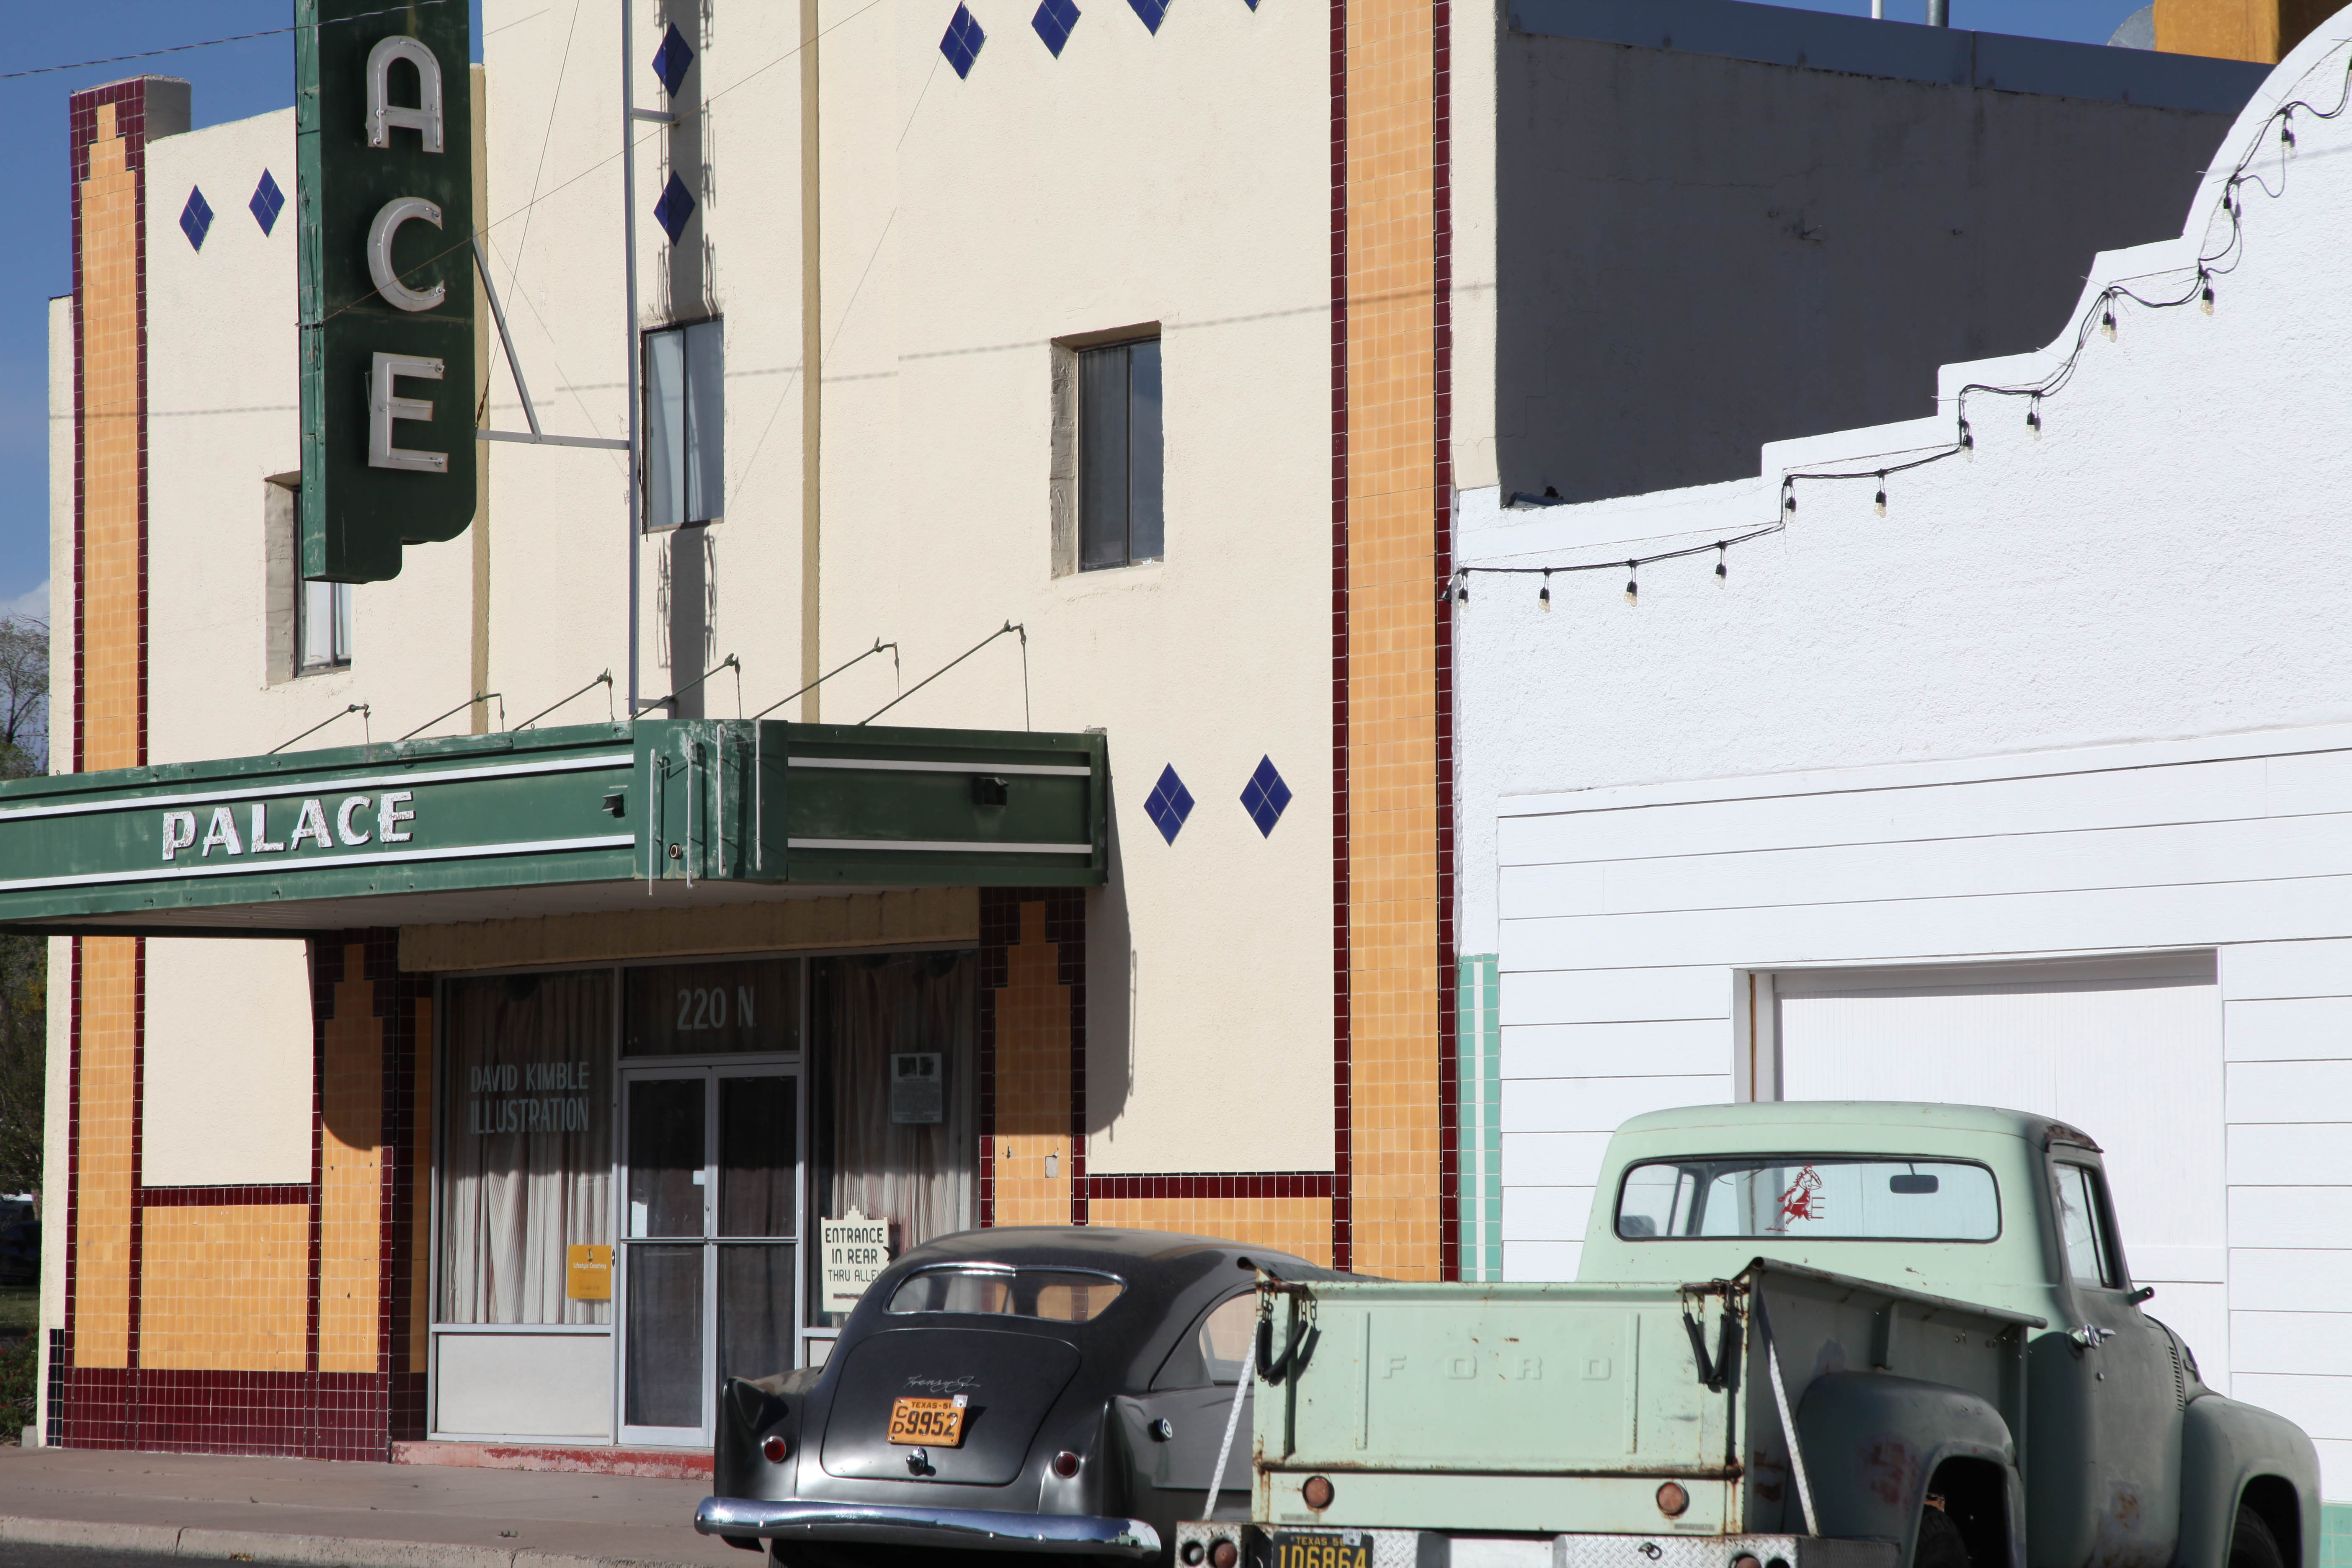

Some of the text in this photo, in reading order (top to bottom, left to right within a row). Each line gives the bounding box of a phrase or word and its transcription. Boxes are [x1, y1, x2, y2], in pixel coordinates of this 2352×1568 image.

[366, 35, 449, 473] ACE
[162, 790, 416, 861] PALACE
[677, 987, 727, 1030] 220
[471, 1061, 590, 1092] DAVID KIMBLE
[471, 1097, 589, 1134] ILLUSTRATION
[825, 1228, 884, 1243] ENTRANCE
[832, 1248, 878, 1264] IN REAR
[828, 1269, 850, 1282] THRU
[1382, 1354, 1612, 1381] FORD
[905, 1411, 958, 1436] 9952
[1297, 1536, 1328, 1546] TEXAS
